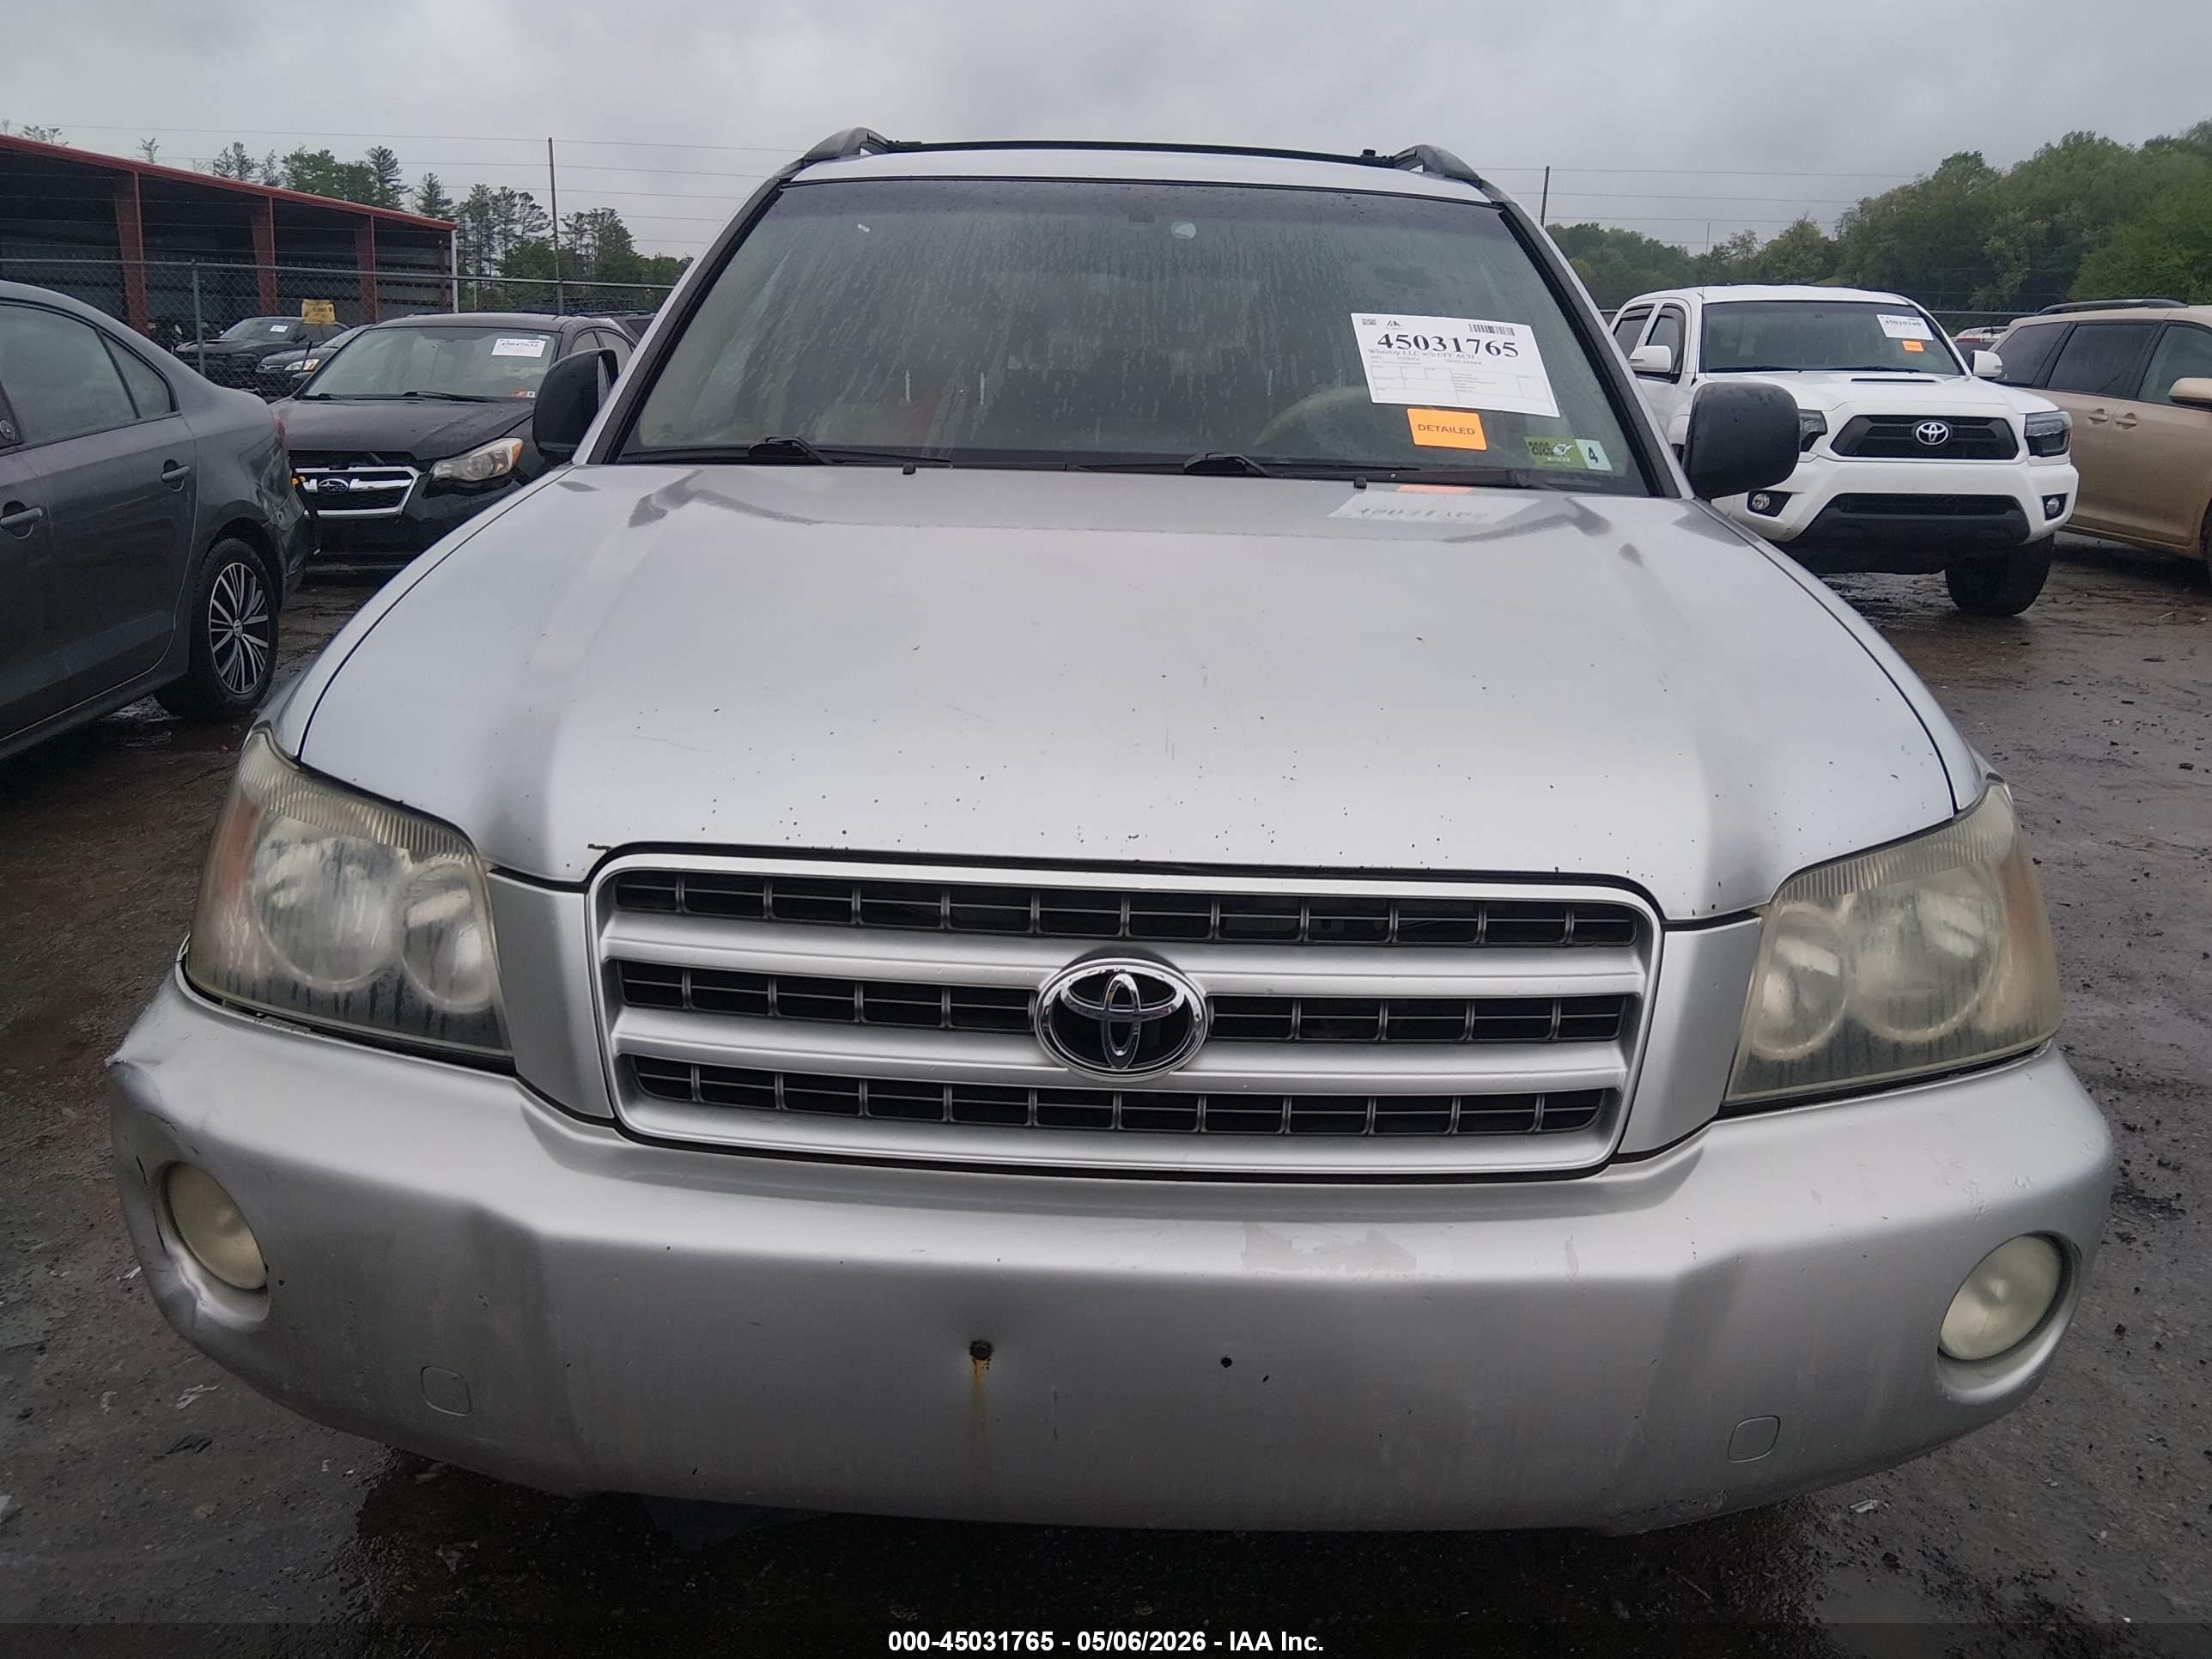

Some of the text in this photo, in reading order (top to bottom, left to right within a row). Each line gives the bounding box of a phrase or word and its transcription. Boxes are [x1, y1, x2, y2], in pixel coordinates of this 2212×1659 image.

[1376, 333, 1519, 358] 45031765
[1417, 422, 1475, 435] DETAILED
[1588, 447, 1599, 464] 4
